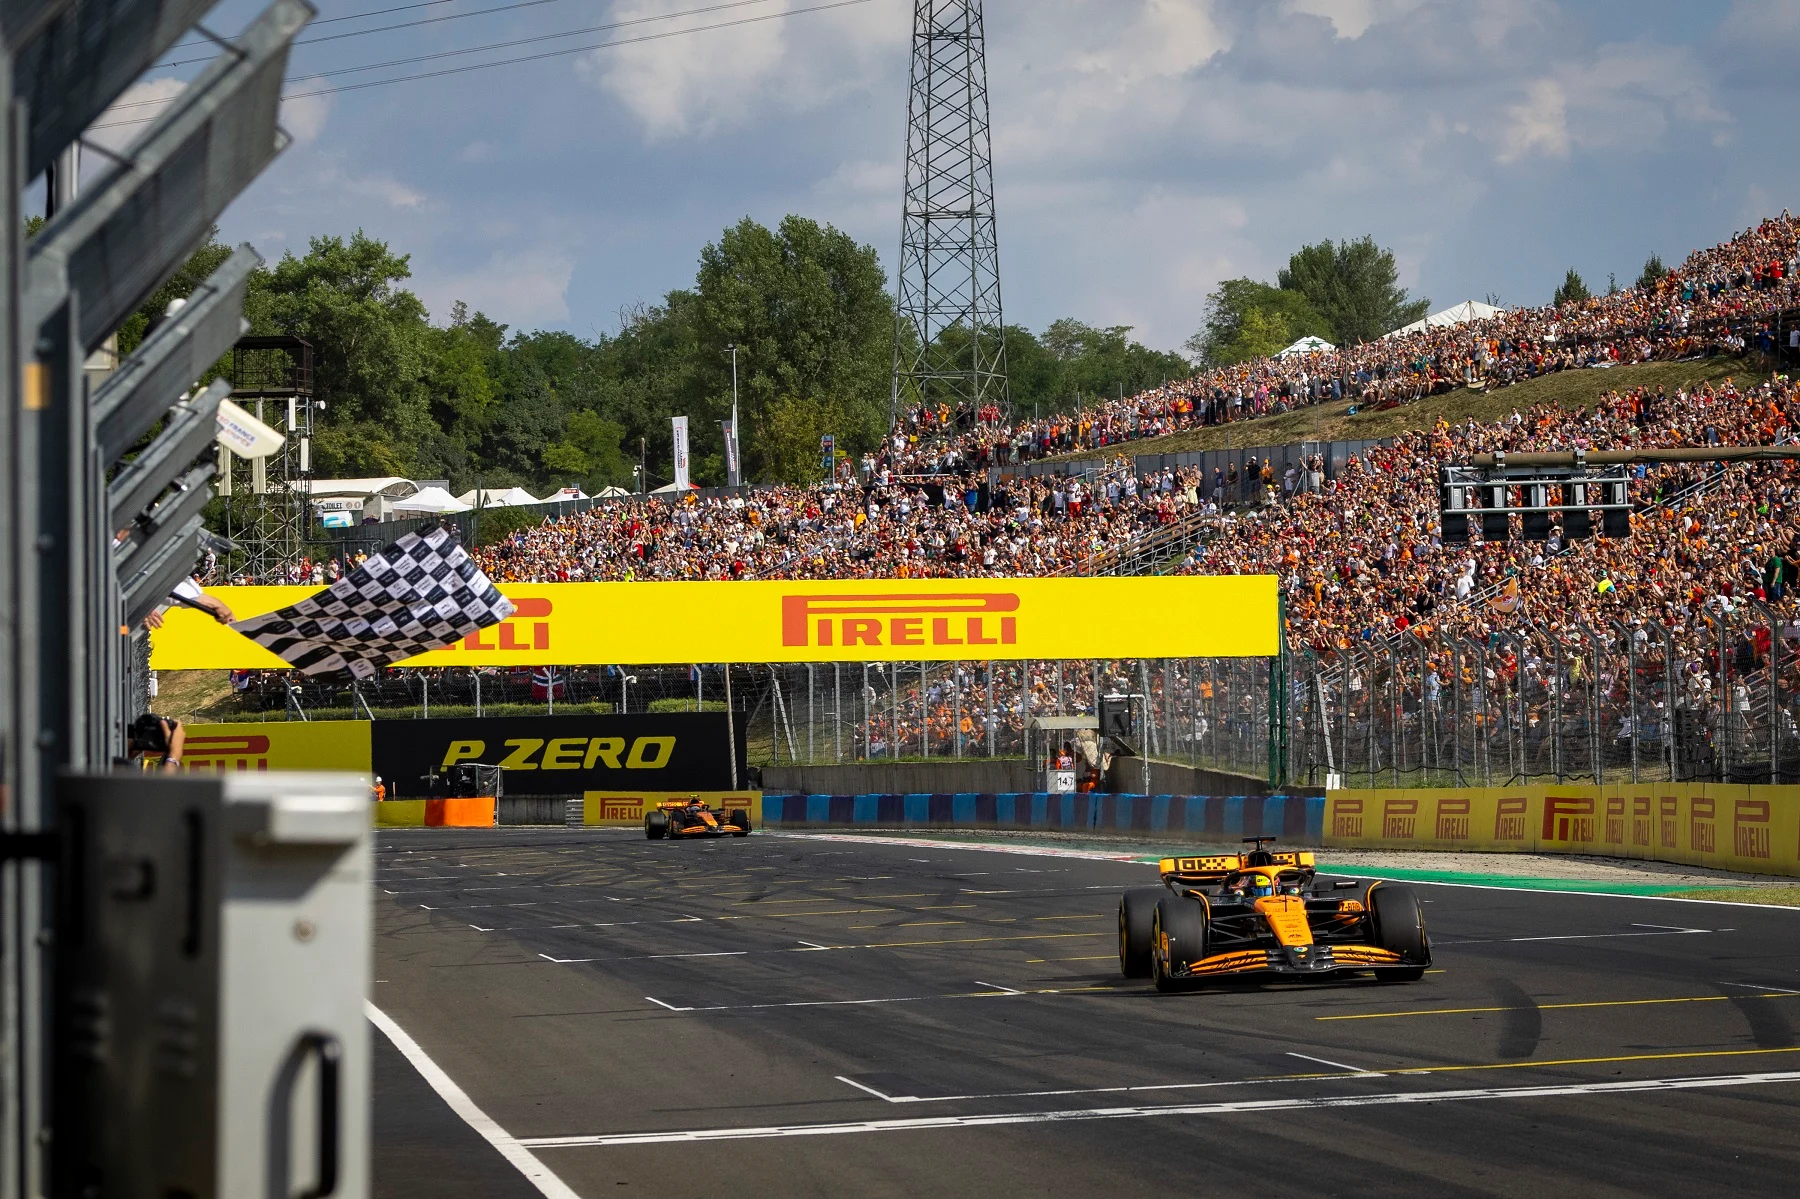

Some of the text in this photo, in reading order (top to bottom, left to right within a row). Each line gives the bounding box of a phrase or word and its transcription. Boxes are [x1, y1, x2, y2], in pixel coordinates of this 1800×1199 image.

[782, 593, 1020, 646] PIRELLI
[440, 736, 676, 772] P ZERO
[600, 798, 643, 820] PIRELLI
[1332, 799, 1364, 838] PIRELLI
[1382, 800, 1419, 838] PIRELLI
[1436, 799, 1471, 839] PIRELLI
[1494, 798, 1528, 840] PIRELLI
[1542, 797, 1595, 842] PIRELLI
[1734, 800, 1770, 859] PIRELLI
